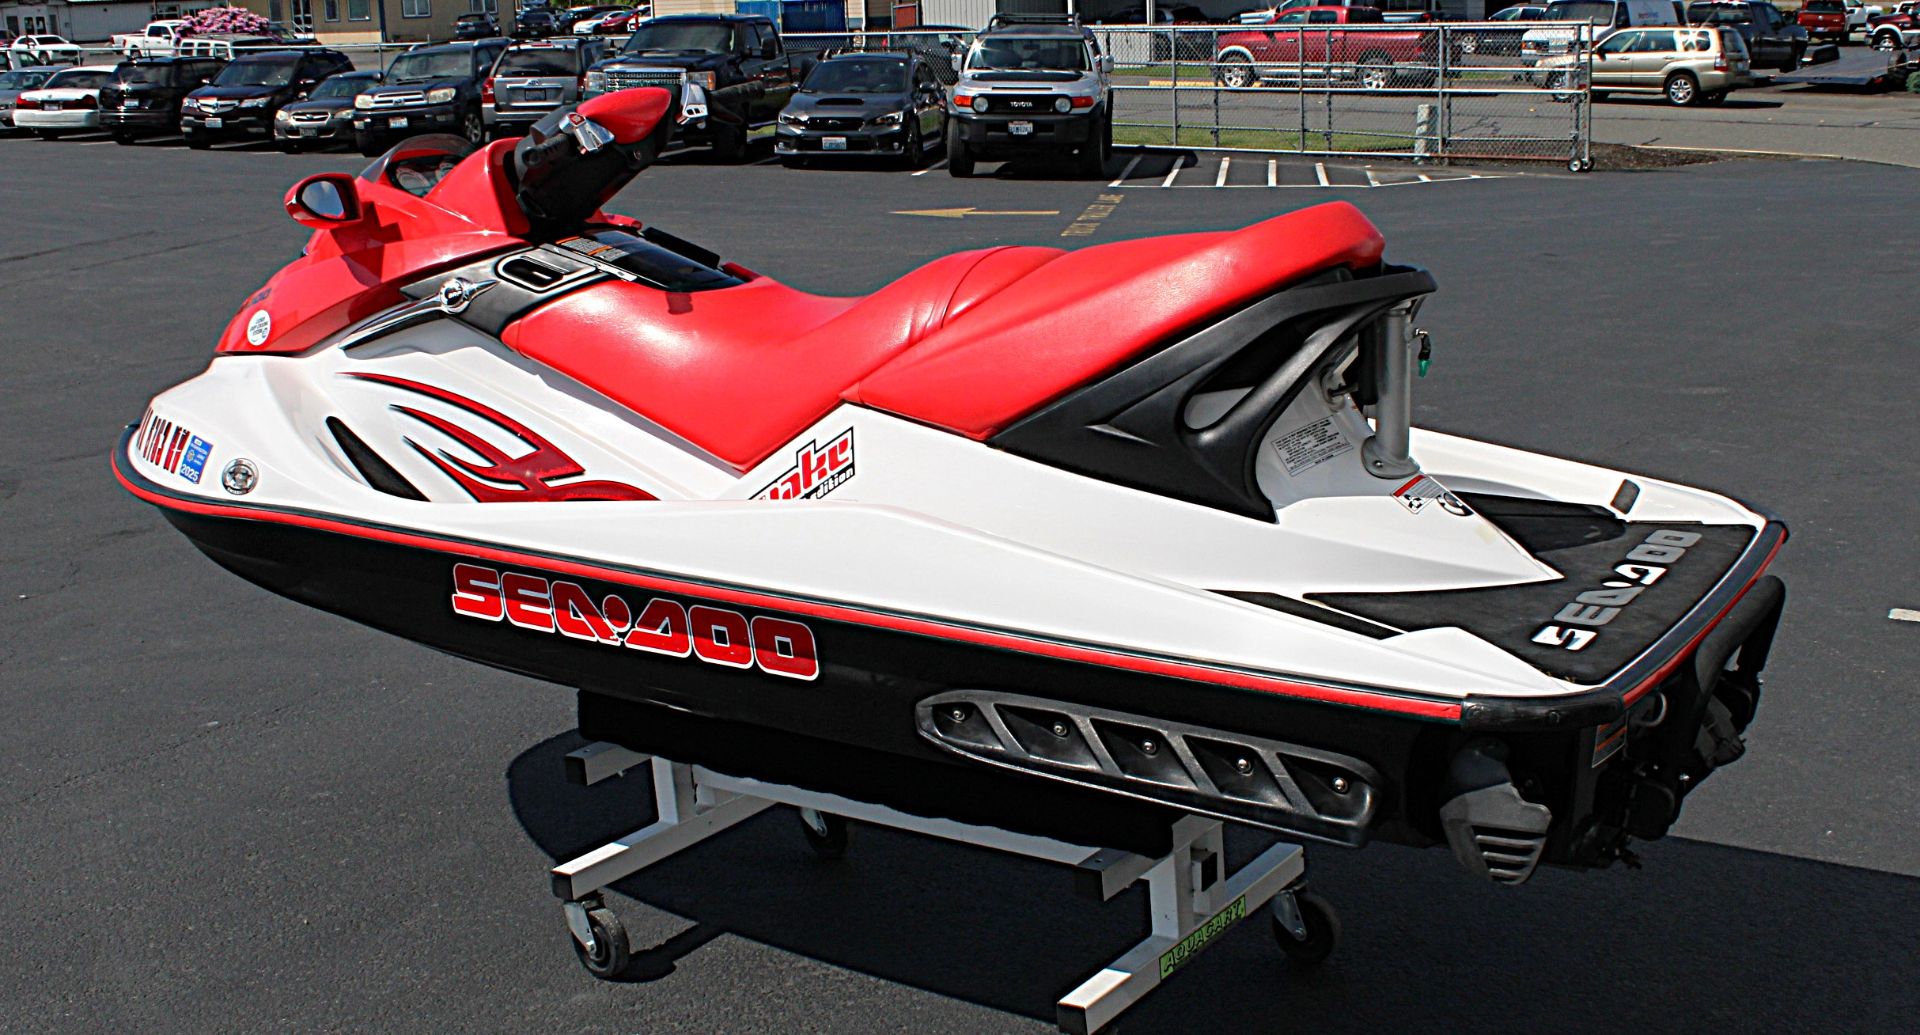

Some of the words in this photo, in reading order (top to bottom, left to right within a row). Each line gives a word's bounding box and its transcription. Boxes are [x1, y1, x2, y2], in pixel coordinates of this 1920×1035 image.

[181, 463, 200, 482] 2025
[758, 437, 850, 500] ake
[810, 467, 854, 500] dition
